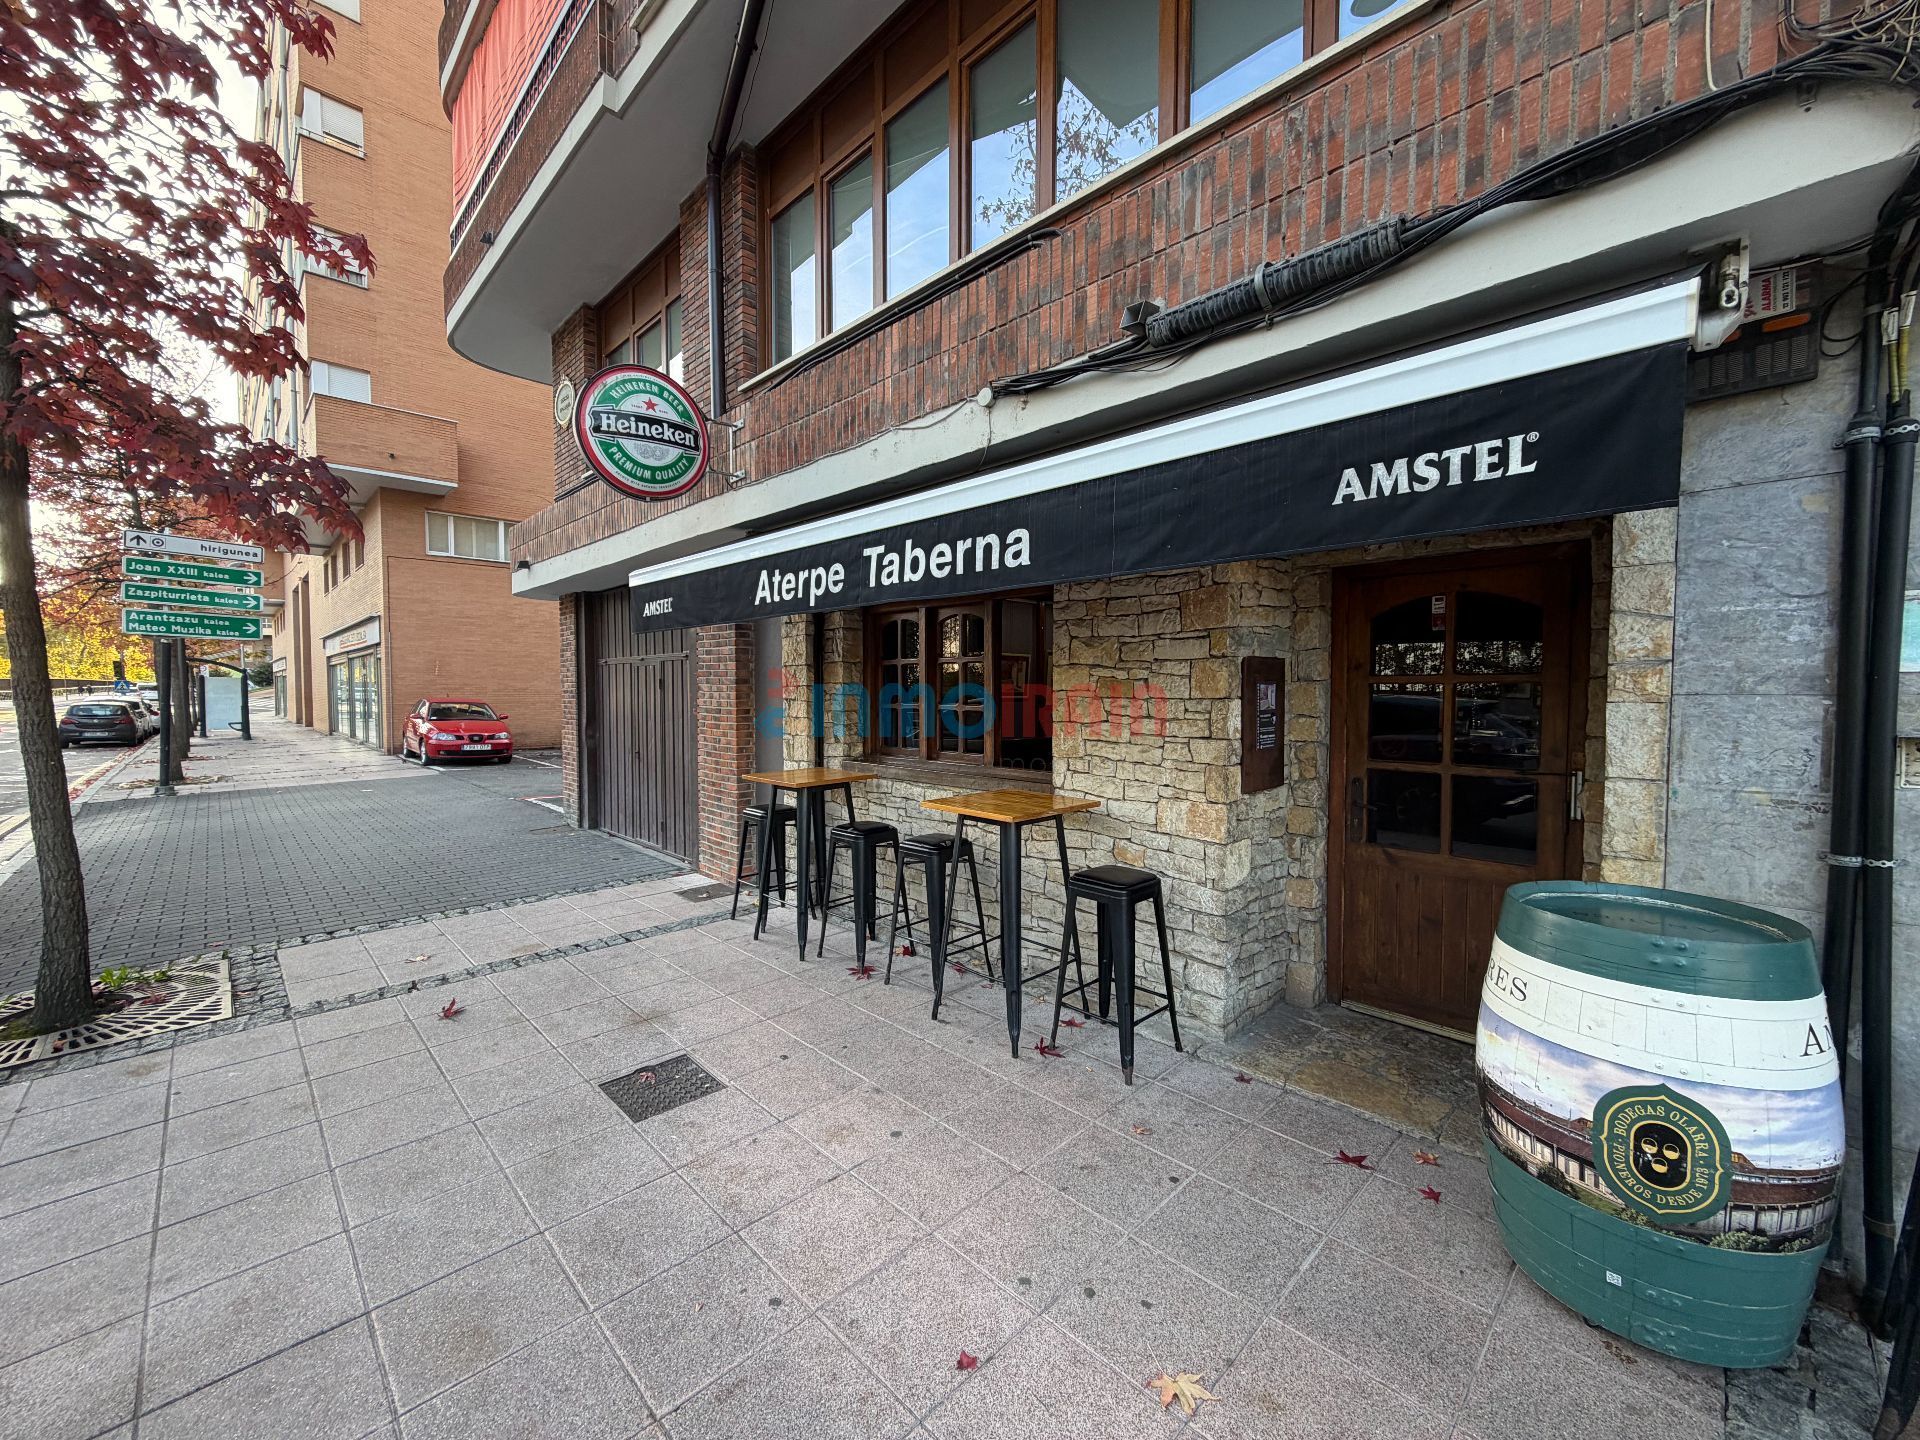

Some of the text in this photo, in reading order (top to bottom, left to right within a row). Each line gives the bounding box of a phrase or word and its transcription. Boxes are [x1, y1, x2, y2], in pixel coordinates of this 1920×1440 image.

[1761, 276, 1772, 311] ALARMA
[610, 381, 685, 412] HEINEKEN BEER
[600, 413, 696, 447] Heineken
[608, 446, 652, 479] PREMIUM
[655, 457, 689, 480] QUALITY
[200, 544, 258, 558] hirigunea
[754, 527, 1031, 606] Aterpe Taberna
[128, 561, 230, 580] Joan XXIII kalea
[127, 587, 239, 605] Zazpiturrieta kalea
[128, 622, 240, 637] Mateo Muxika kalea
[129, 611, 230, 626] Arantzazu kalea
[1613, 1105, 1710, 1158] BODEGAS OLARRA
[1612, 1143, 1709, 1206] PIONEROS DESDE 1973
